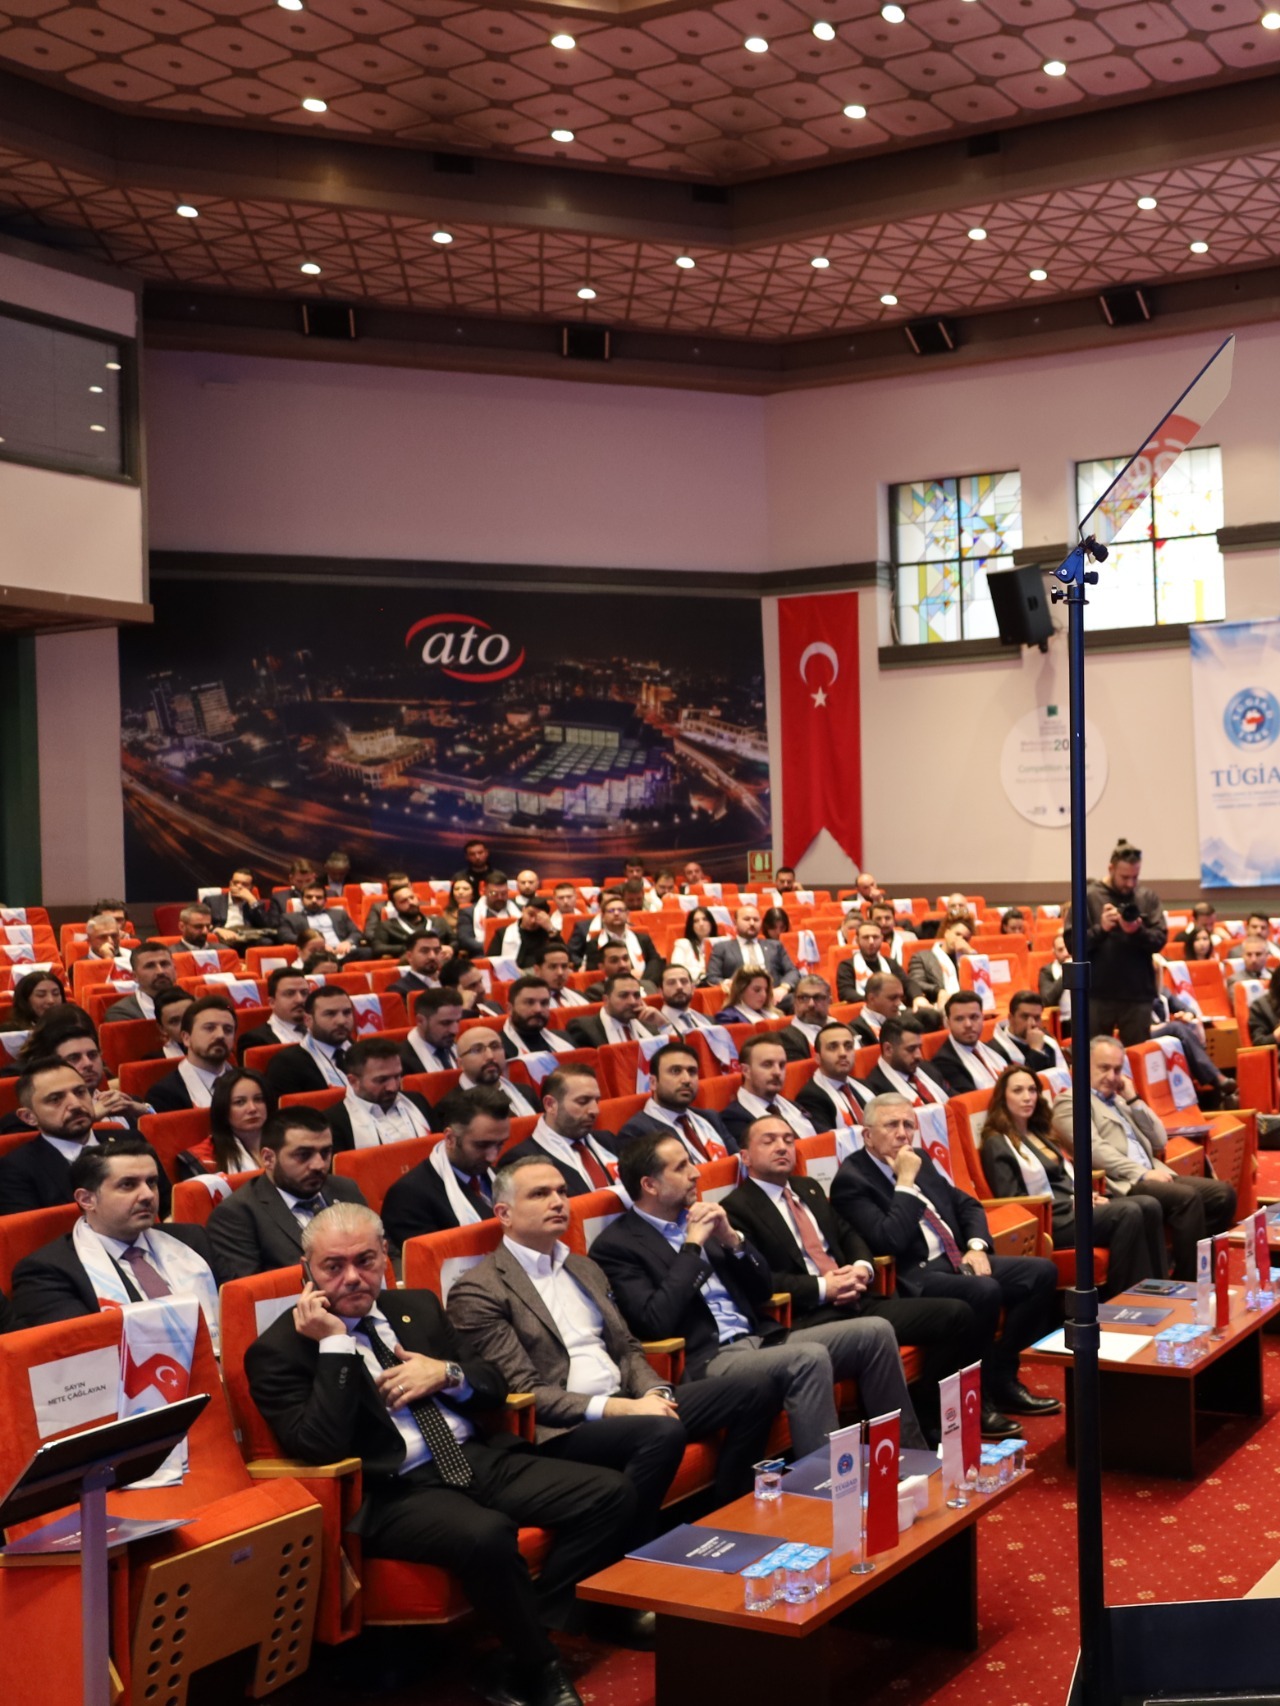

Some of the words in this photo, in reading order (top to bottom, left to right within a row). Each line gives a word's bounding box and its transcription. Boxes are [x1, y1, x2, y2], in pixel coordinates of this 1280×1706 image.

[422, 625, 510, 665] ato
[64, 1382, 85, 1391] SAYIN
[48, 1396, 65, 1405] METE
